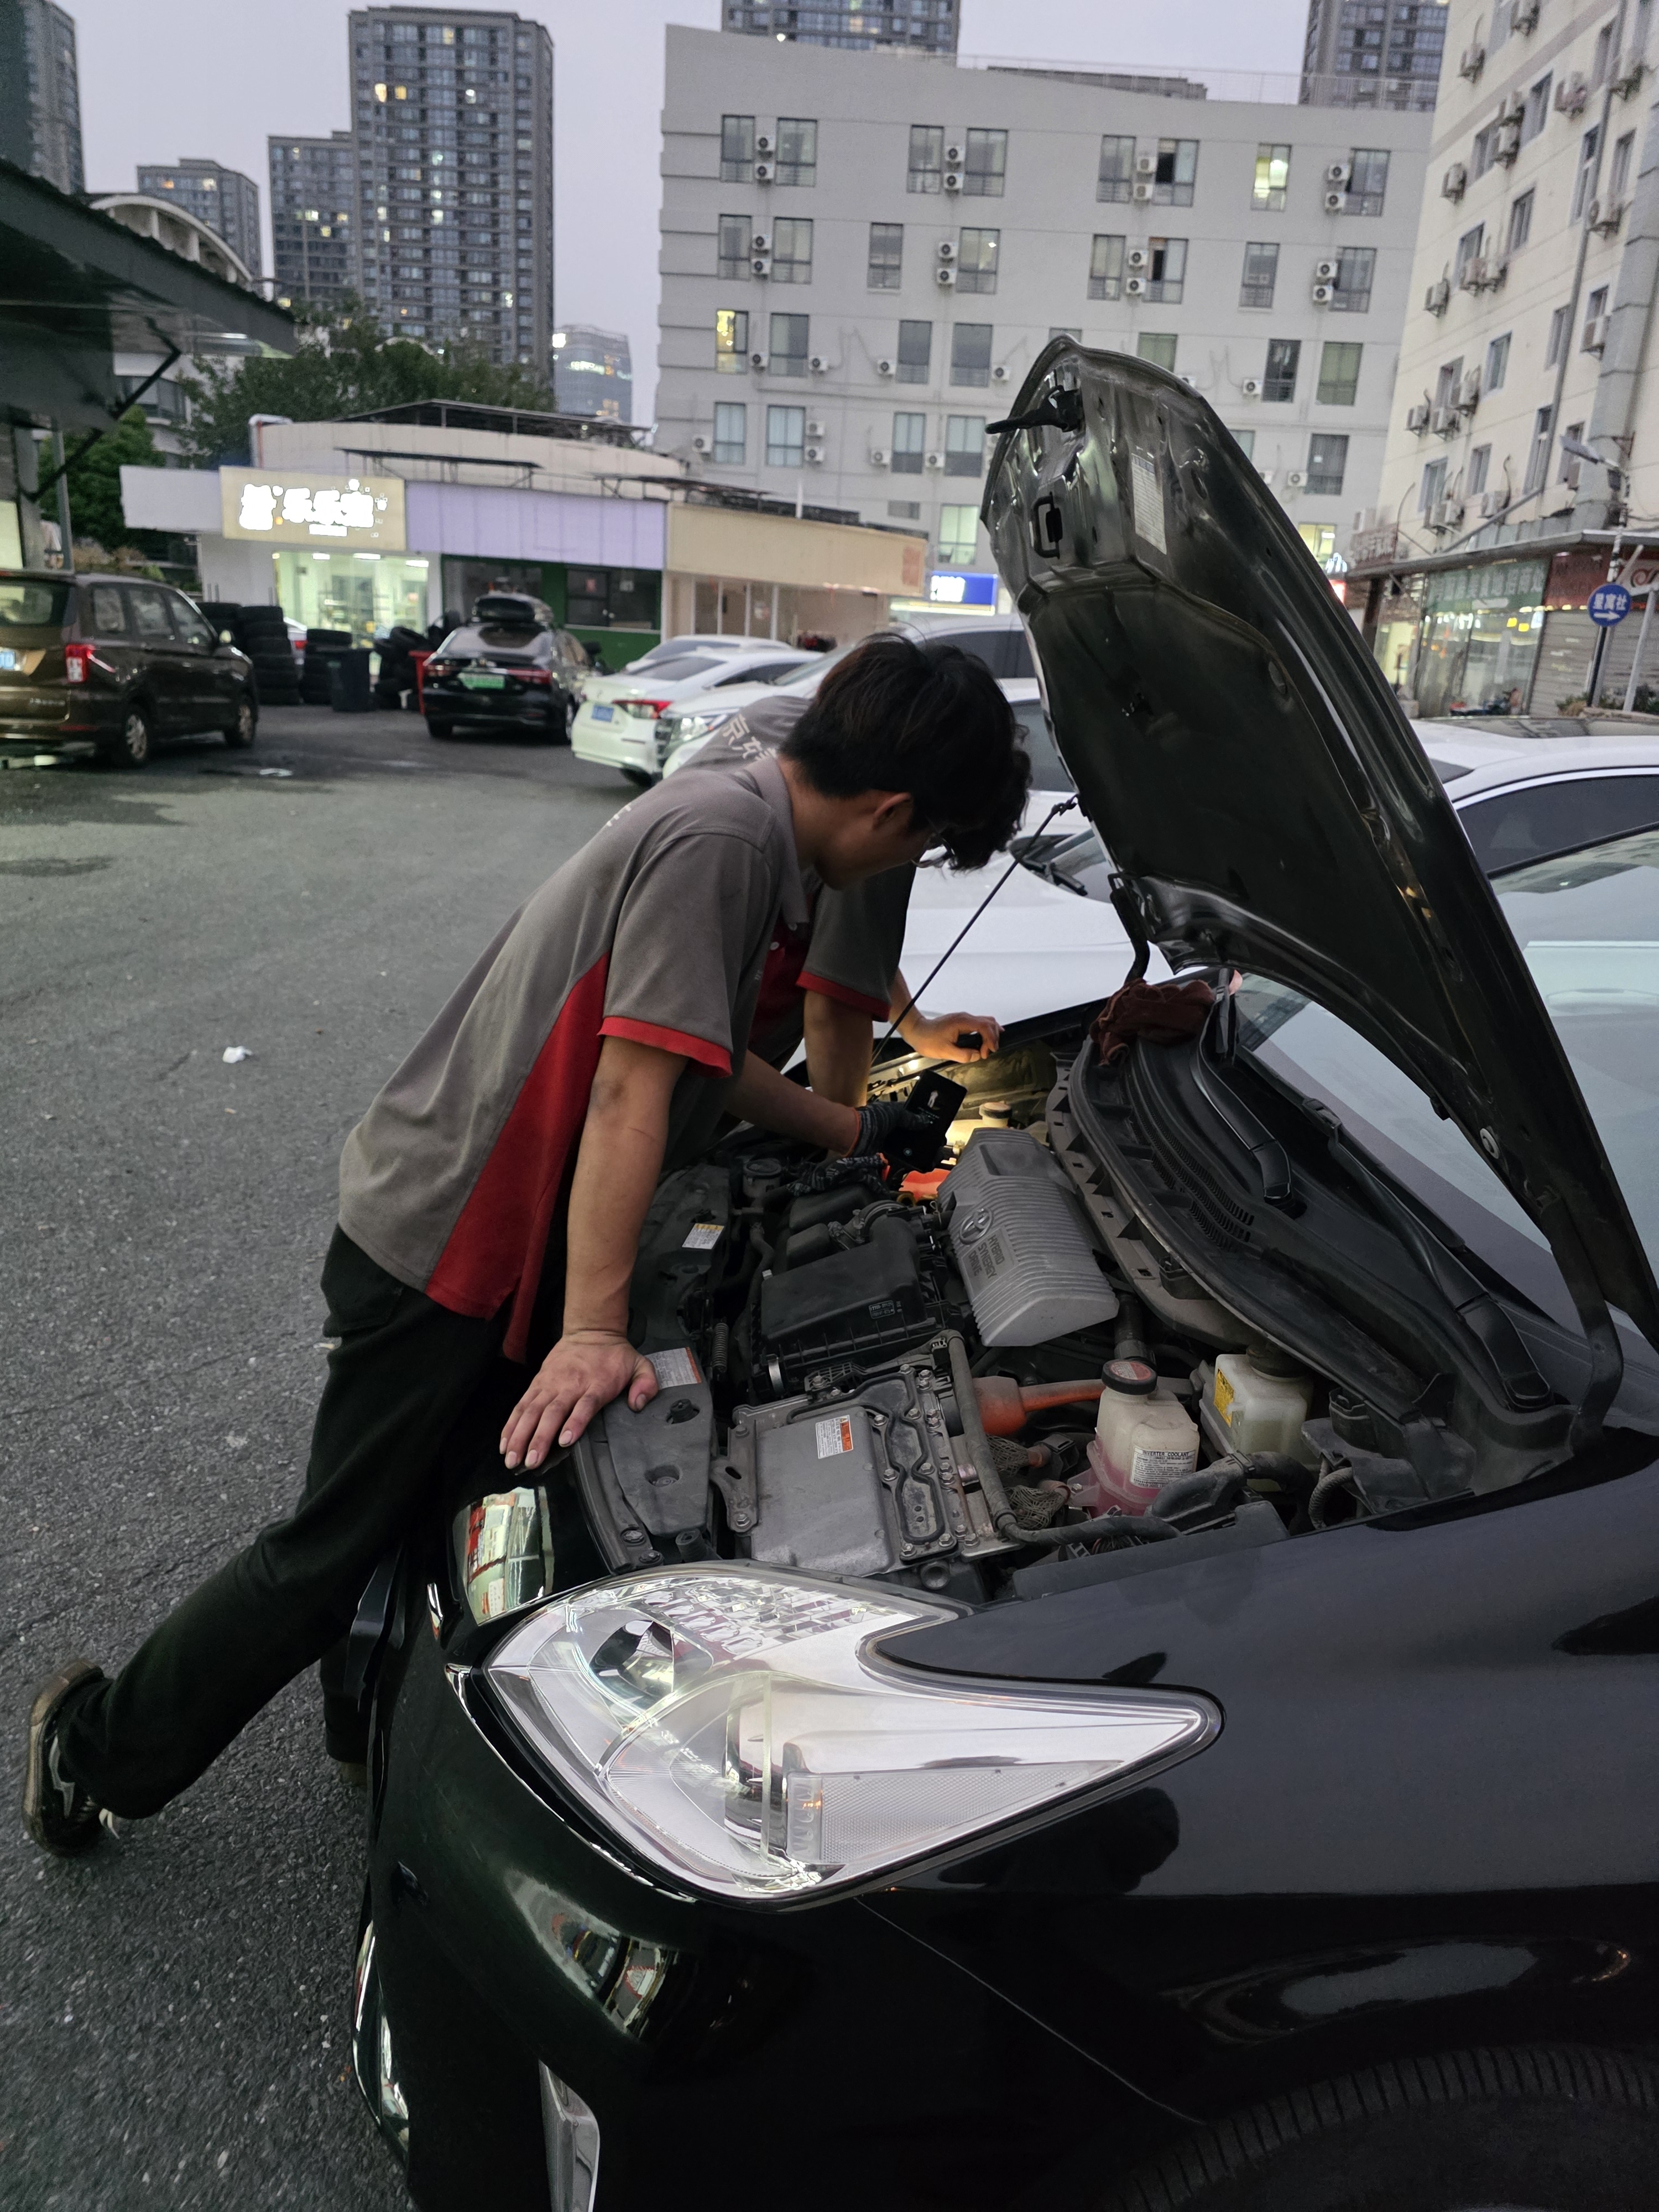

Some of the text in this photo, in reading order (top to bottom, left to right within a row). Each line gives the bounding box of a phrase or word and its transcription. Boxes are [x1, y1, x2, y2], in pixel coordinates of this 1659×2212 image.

[968, 1250, 983, 1276] DRIVE
[978, 1242, 997, 1279] SYNERGY
[987, 1234, 1005, 1265] HYBRID
